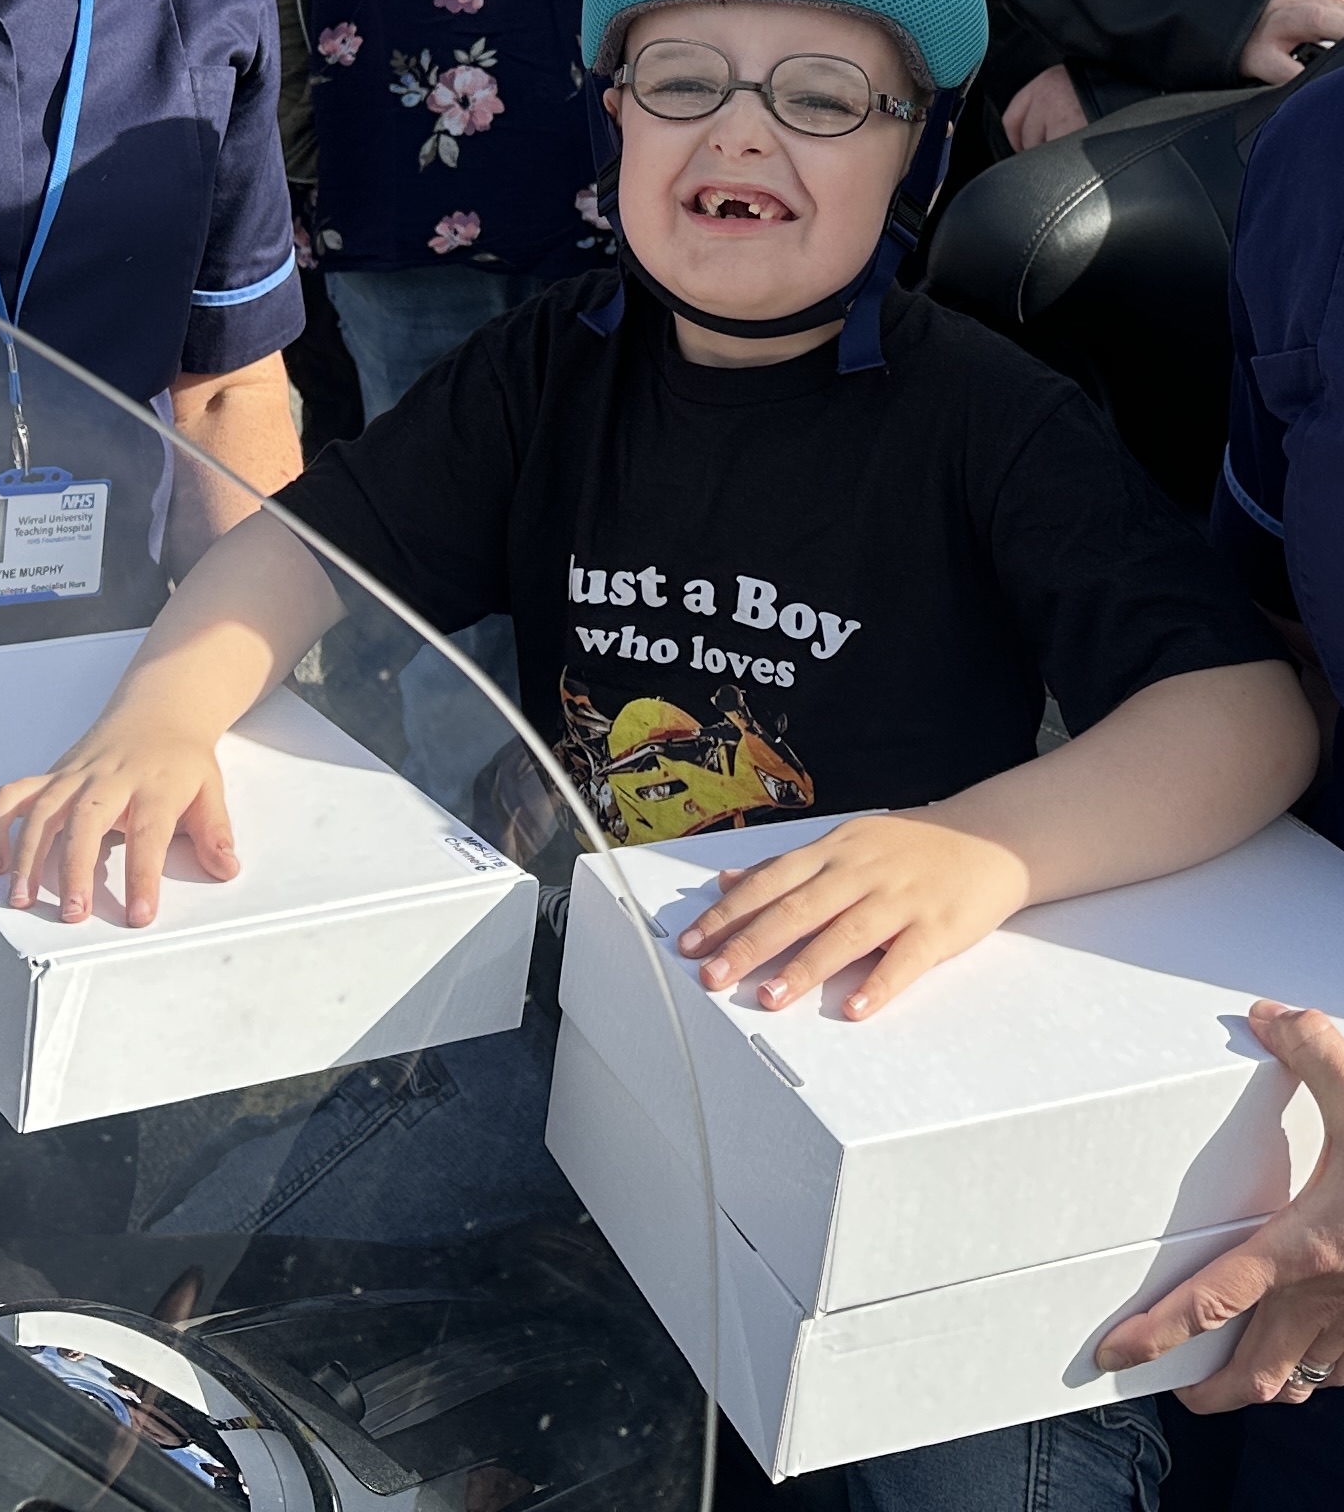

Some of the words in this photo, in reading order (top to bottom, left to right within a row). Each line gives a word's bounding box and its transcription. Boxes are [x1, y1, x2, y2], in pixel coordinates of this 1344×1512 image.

[61, 493, 94, 510] NHS
[18, 514, 47, 526] Wirral
[49, 512, 93, 524] University
[14, 524, 54, 538] Teaching
[56, 522, 93, 535] Hospital
[19, 563, 65, 578] MURPHY
[568, 553, 668, 608] ust
[683, 578, 718, 617] a
[731, 574, 863, 660] Boy
[574, 625, 680, 665] who
[689, 635, 796, 688] loves
